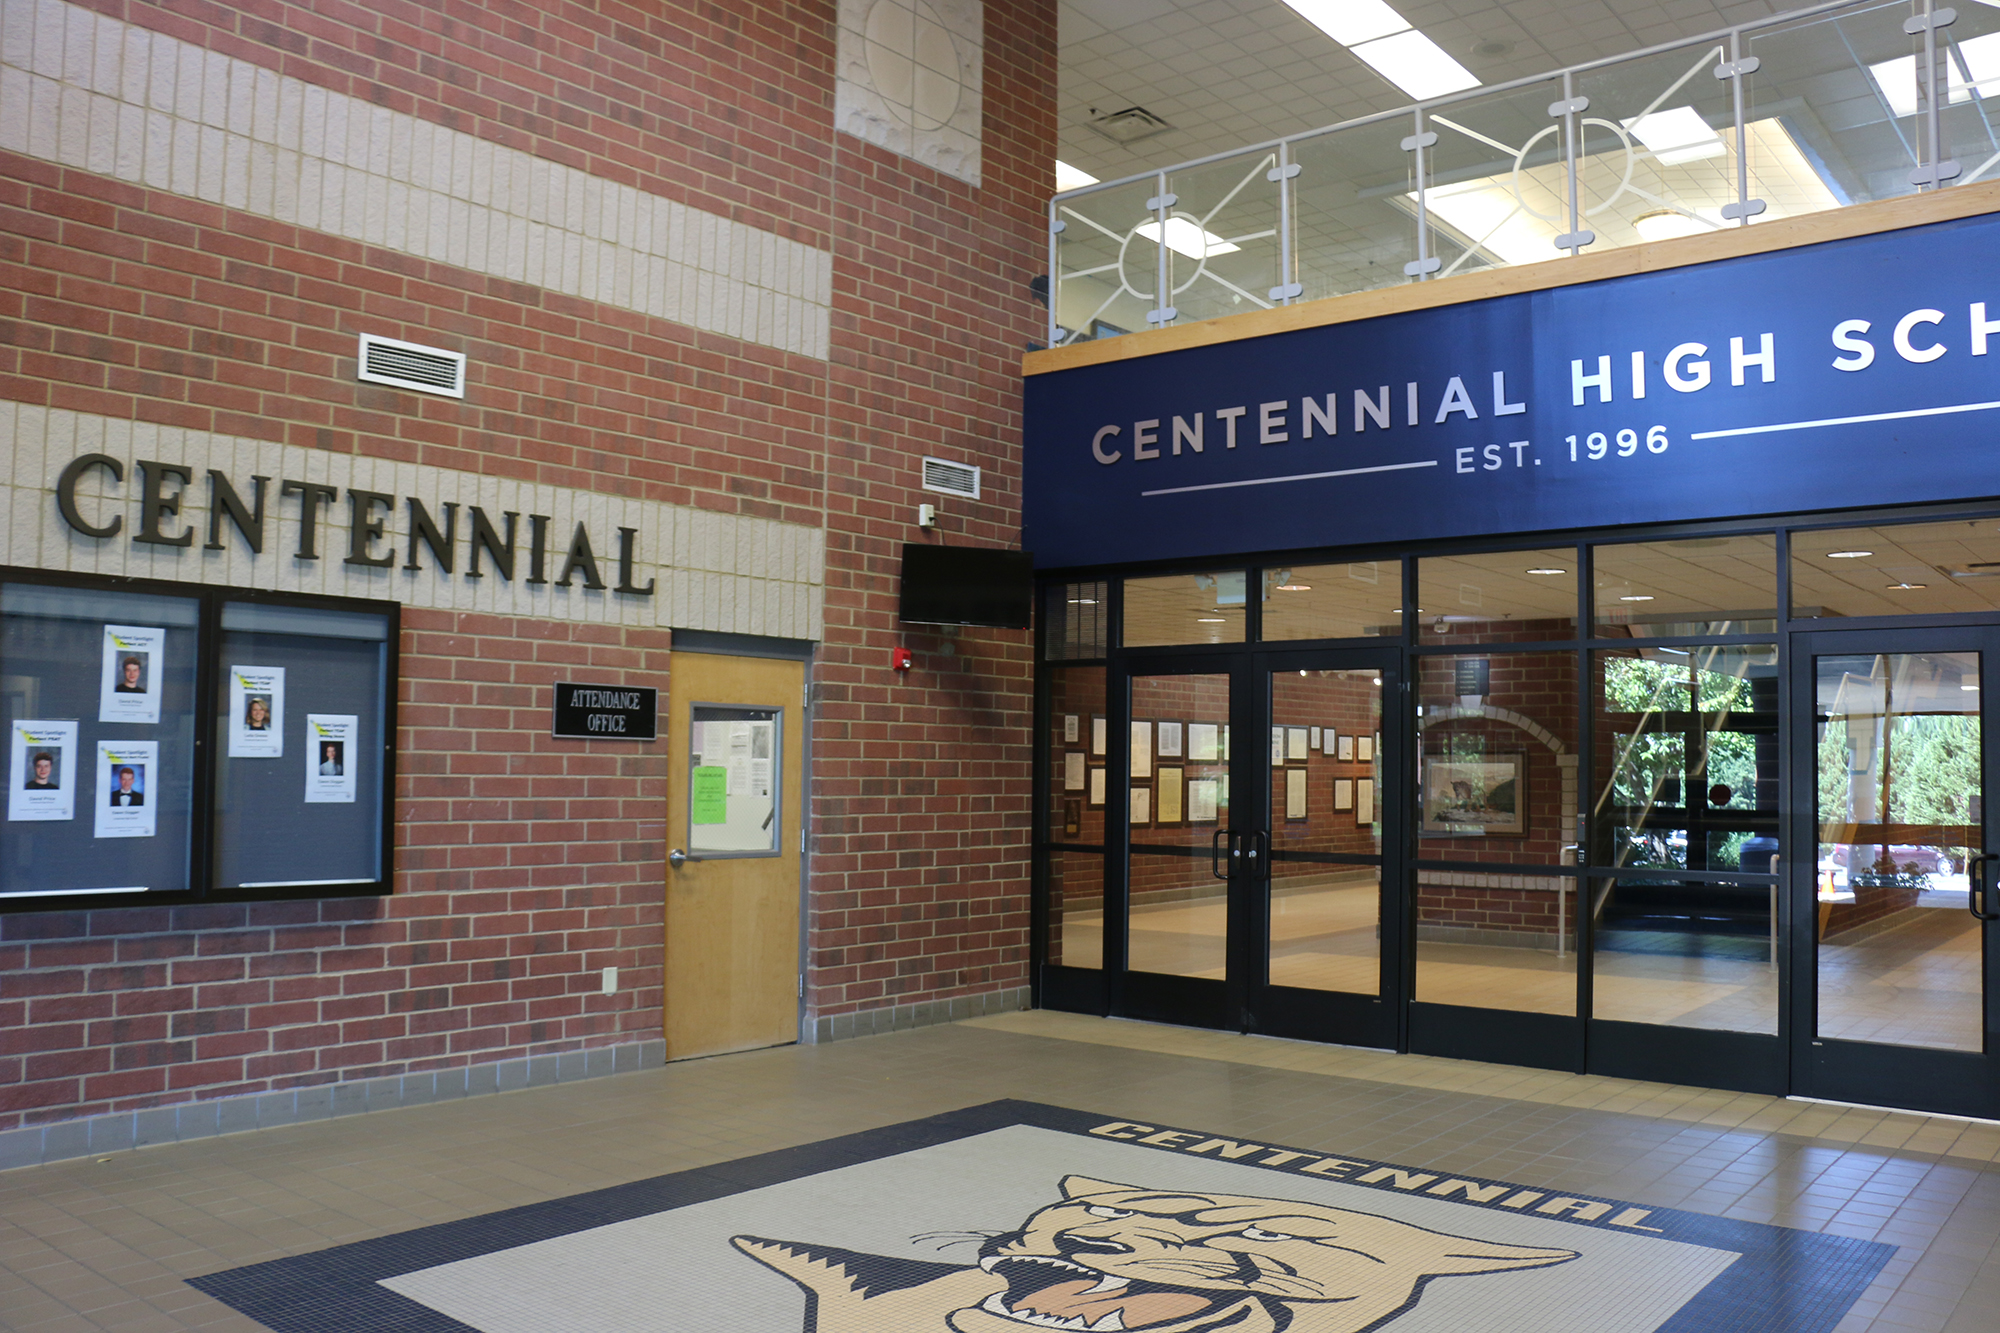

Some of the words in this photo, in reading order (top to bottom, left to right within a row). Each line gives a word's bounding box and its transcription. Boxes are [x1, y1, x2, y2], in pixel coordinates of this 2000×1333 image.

[1092, 371, 1527, 465] CENTENNIAL
[1571, 332, 1776, 406] HIGH
[1456, 440, 1542, 473] EST.
[1565, 425, 1669, 462] 1996
[57, 453, 655, 596] CENTENNIAL
[570, 689, 641, 710] ATTENDANCE
[587, 713, 626, 732] OFFICE
[1088, 1121, 1666, 1233] CENTENNIAL
